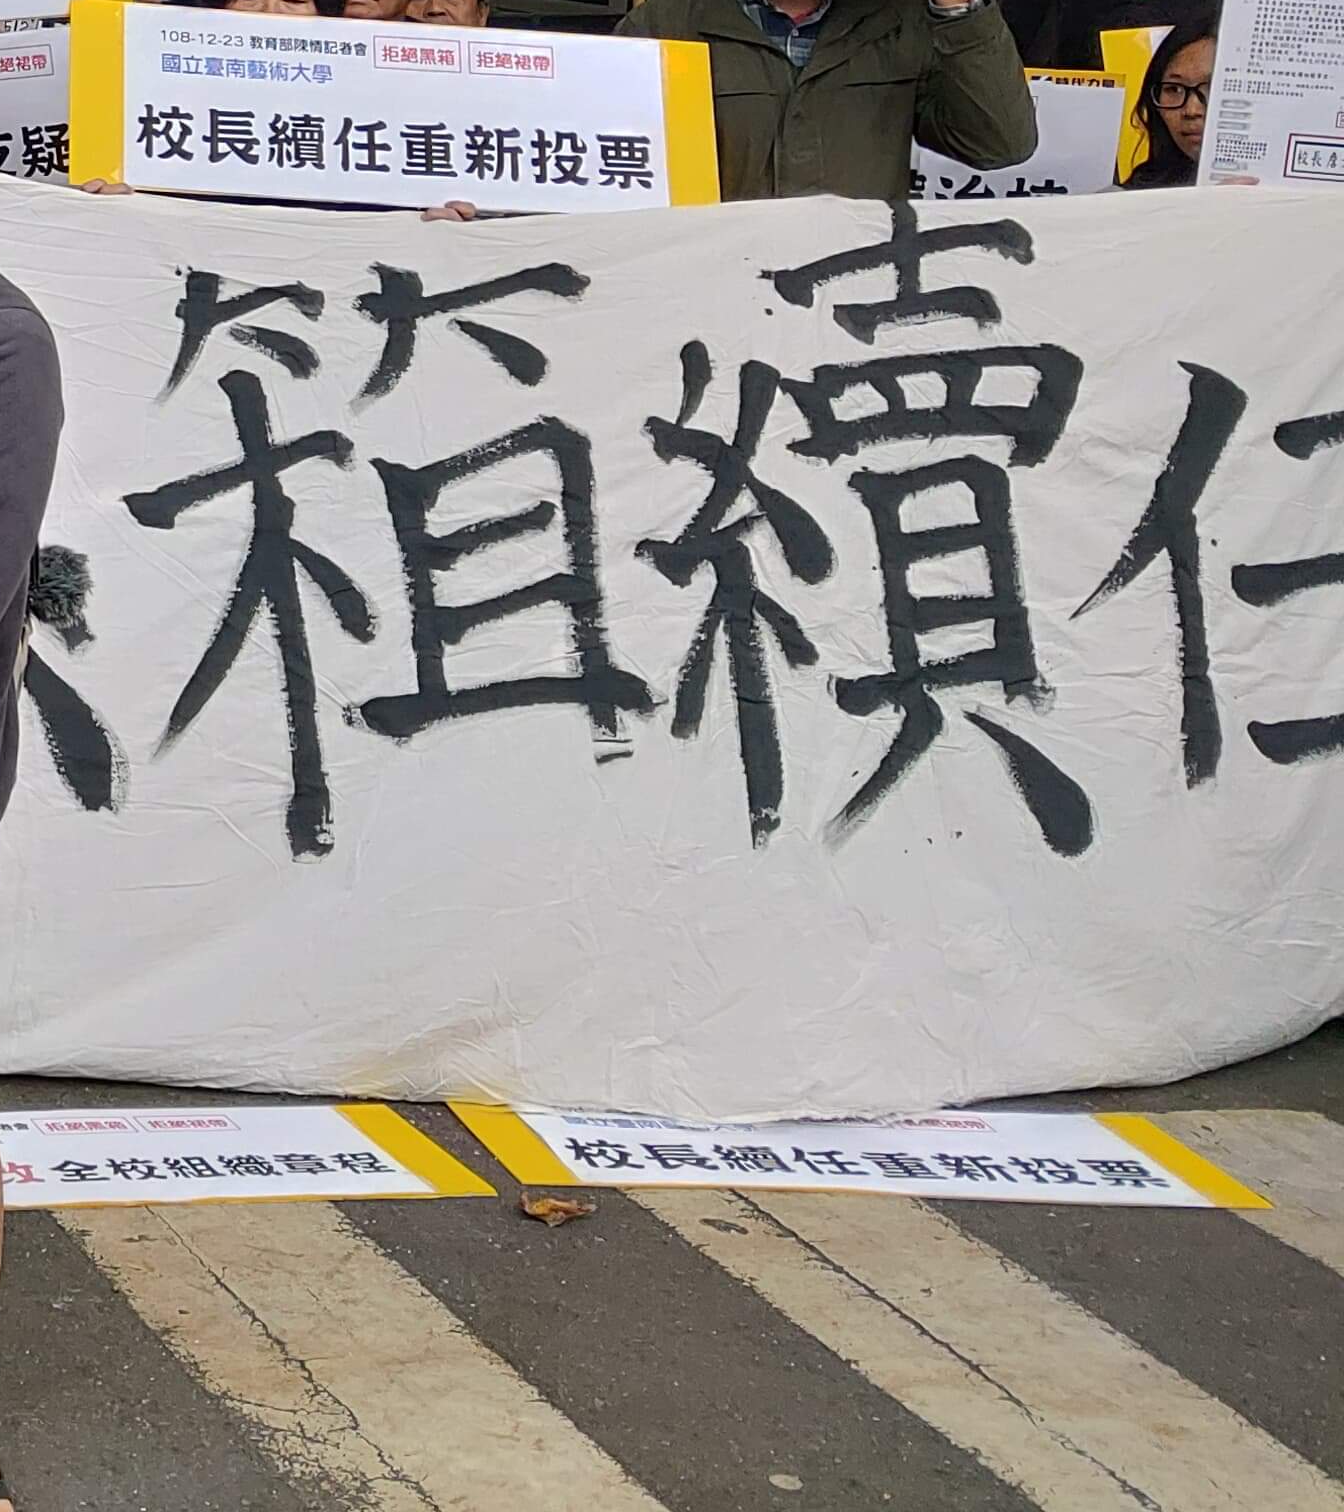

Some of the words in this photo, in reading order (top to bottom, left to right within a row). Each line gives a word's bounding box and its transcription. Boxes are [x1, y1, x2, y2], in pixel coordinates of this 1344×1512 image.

[159, 28, 245, 49] 108-12-23
[249, 34, 368, 58] 教育部陳情記者會
[381, 44, 456, 68] 拒絕黑箱
[160, 53, 334, 85] 國立臺南藝術大學
[476, 51, 552, 73] 拒絕裙帶
[135, 104, 656, 190] 校長續任重新投票
[49, 1150, 395, 1185] 全校組織章程
[563, 1136, 1170, 1190] 校長續任重新投票
